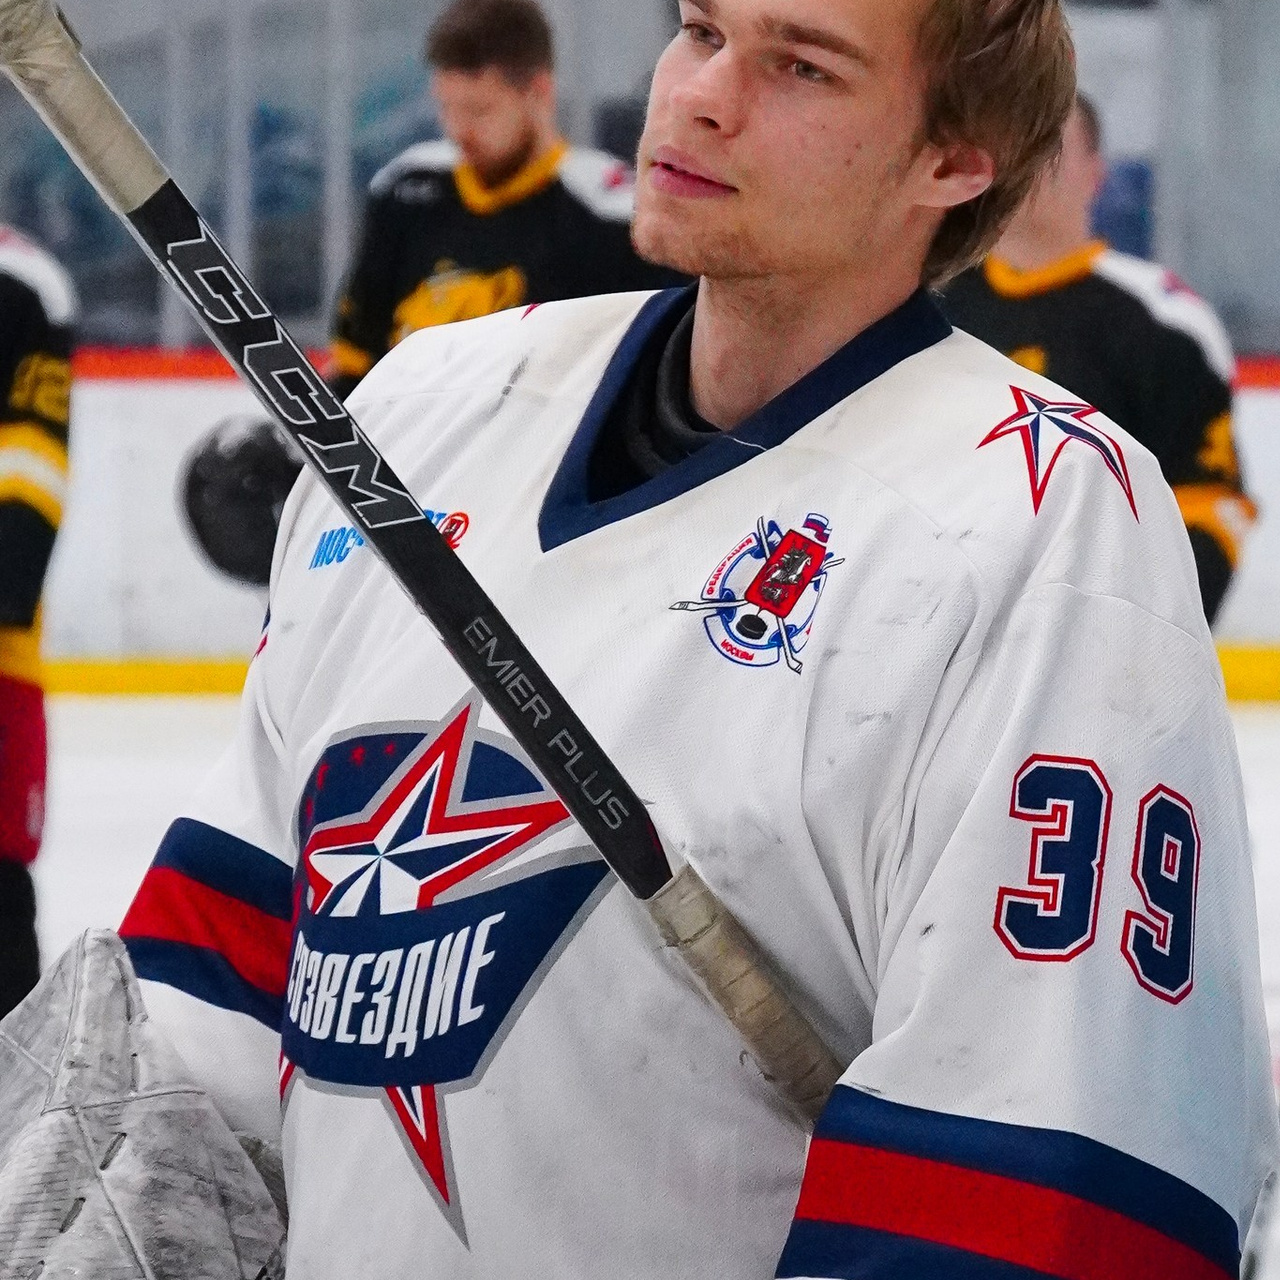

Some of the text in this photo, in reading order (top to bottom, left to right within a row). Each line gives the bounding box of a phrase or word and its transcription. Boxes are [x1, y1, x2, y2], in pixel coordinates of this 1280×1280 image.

[166, 216, 426, 529] CCM
[547, 728, 630, 830] PLUS
[993, 753, 1202, 1005] 39
